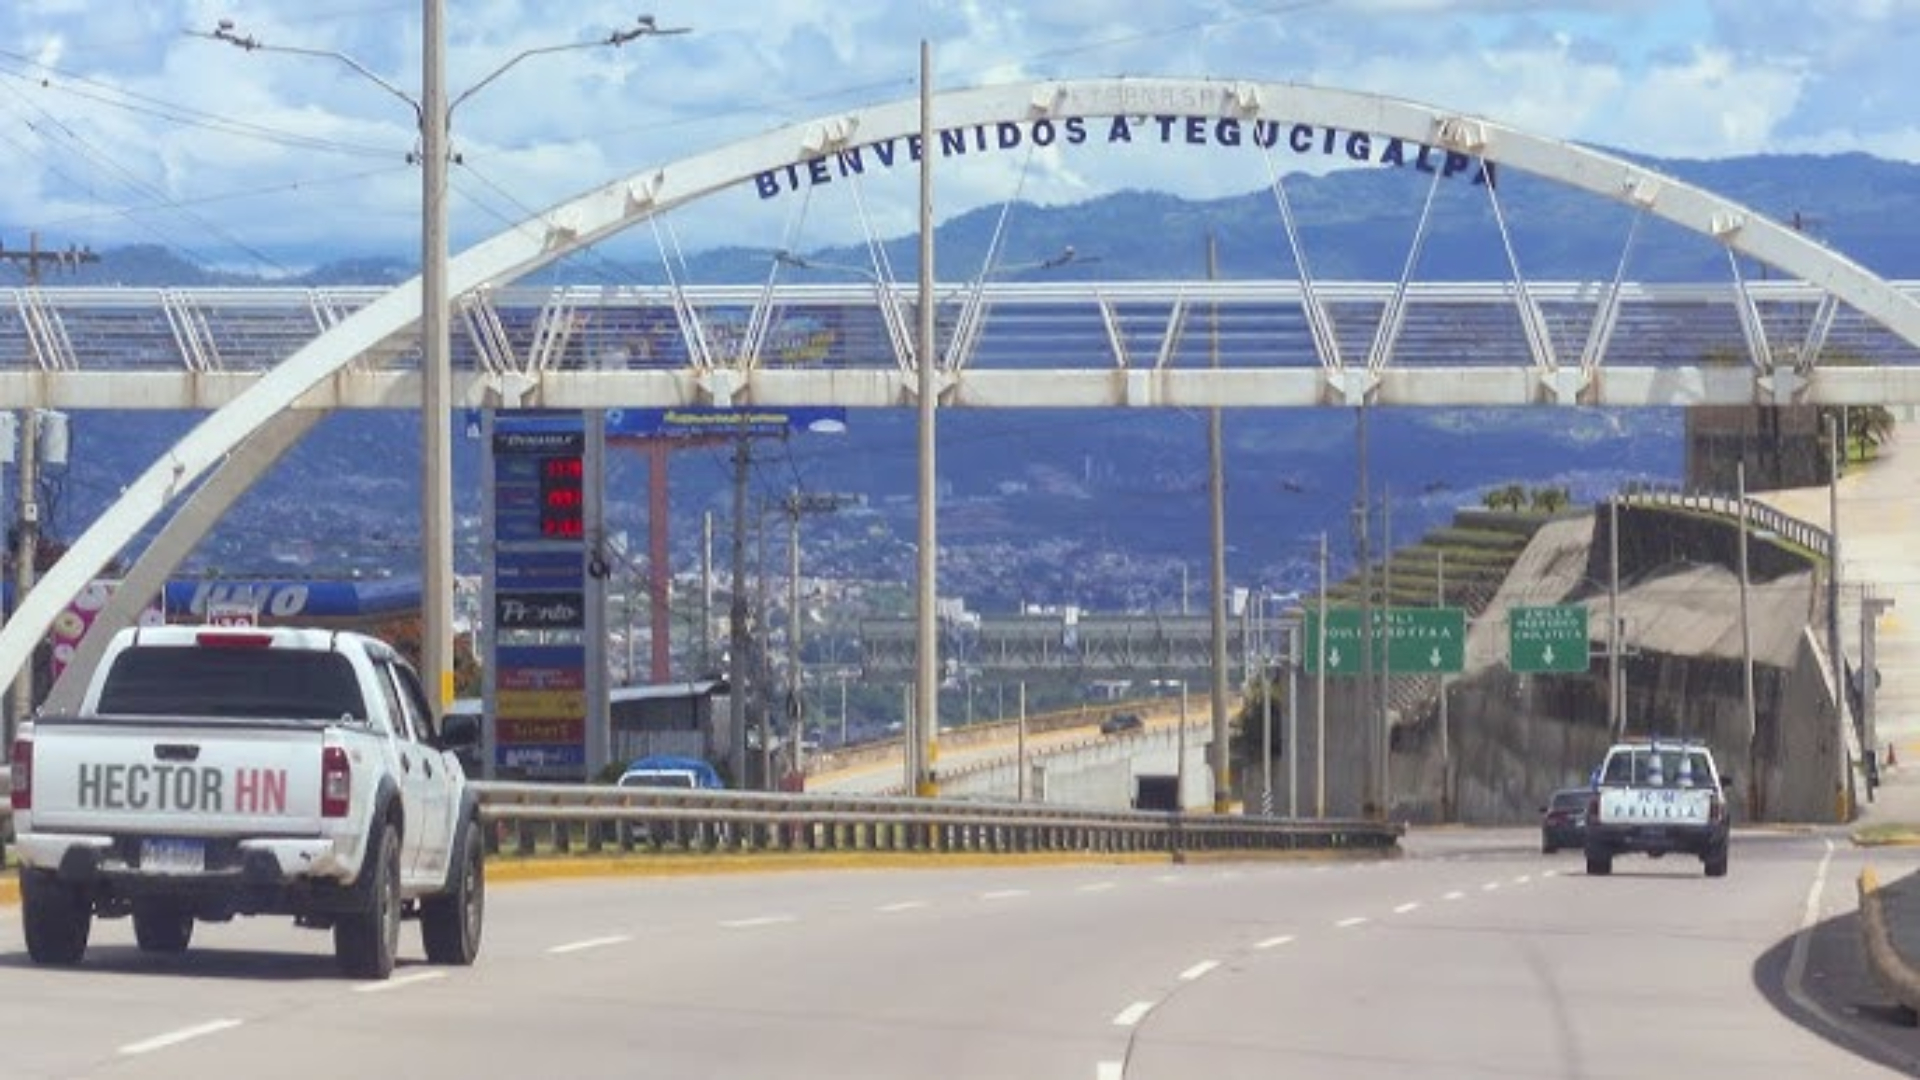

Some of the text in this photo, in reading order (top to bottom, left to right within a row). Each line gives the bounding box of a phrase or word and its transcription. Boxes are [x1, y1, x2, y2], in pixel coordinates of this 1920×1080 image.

[755, 115, 1498, 199] BIENVENIDOS A TEGUCIGALPA
[78, 763, 287, 813] HECTOR HN
